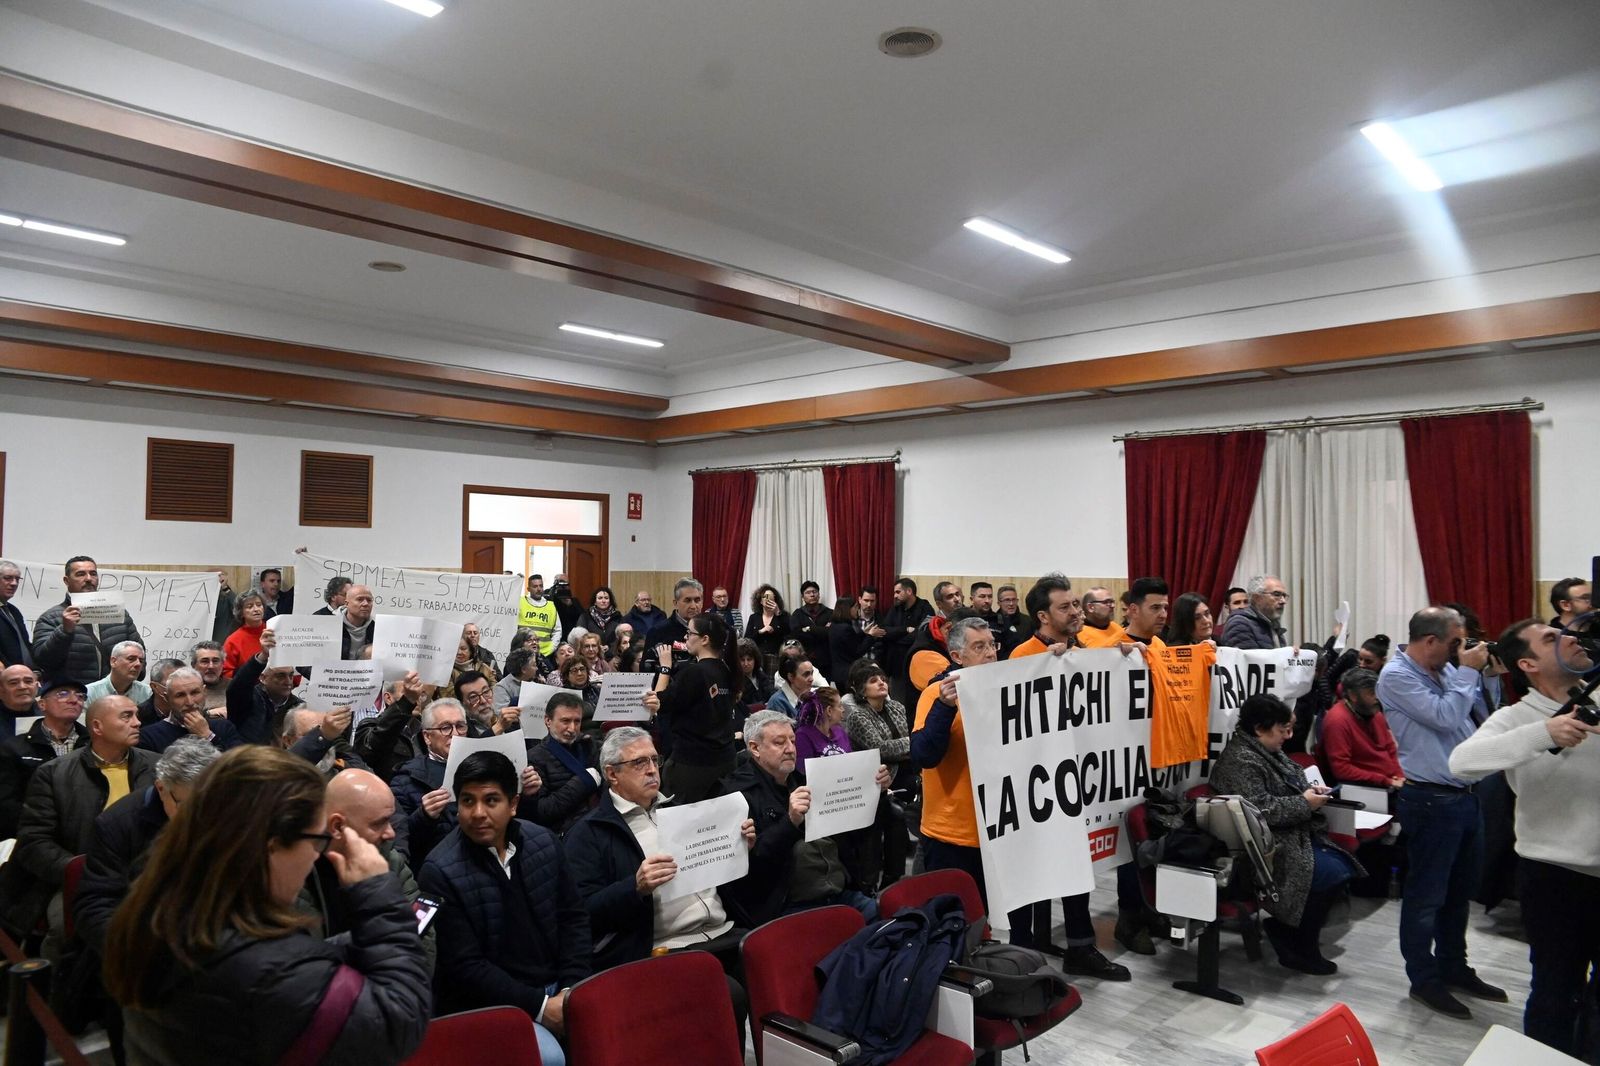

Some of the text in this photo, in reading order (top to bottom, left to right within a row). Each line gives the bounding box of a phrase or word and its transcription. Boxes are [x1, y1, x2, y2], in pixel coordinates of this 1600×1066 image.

[390, 596, 412, 609] SUS
[419, 599, 490, 614] TRABAJADORES
[493, 606, 518, 616] LLEVAN
[164, 627, 201, 639] 2025
[1167, 664, 1191, 674] Hitachi
[1000, 669, 1111, 746] HITACHI
[977, 775, 1020, 841] LA
[697, 824, 717, 834] ALCALDE
[697, 844, 732, 857] TRABAJADORES
[680, 860, 709, 872] MUNICIPALES
[722, 852, 736, 860] LEMA
